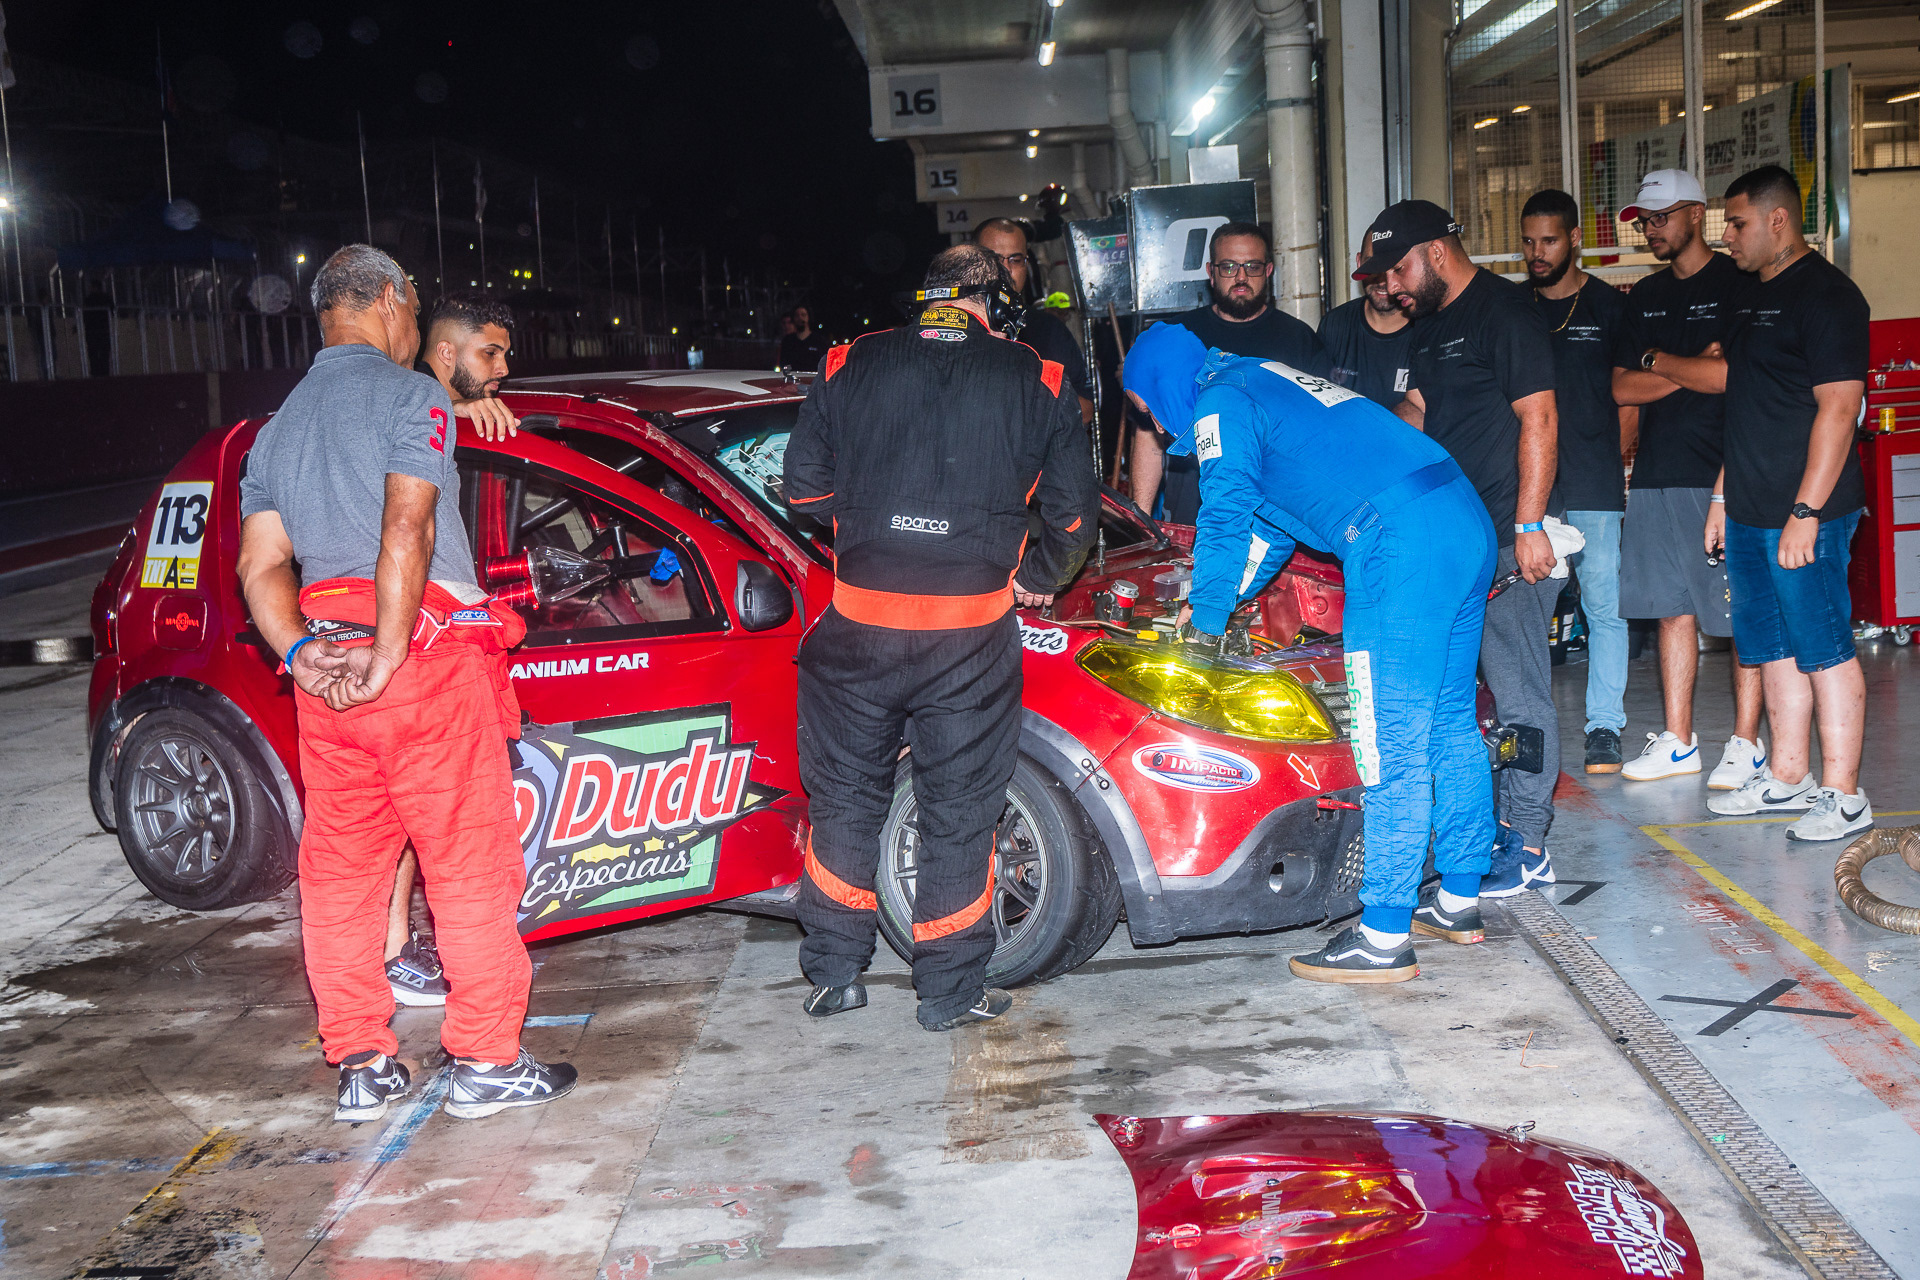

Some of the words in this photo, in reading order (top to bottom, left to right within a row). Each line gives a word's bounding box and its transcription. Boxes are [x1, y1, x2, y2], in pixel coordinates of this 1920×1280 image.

[894, 88, 936, 116] 16
[930, 169, 957, 189] 15
[946, 209, 969, 223] 14
[156, 494, 209, 545] 113
[890, 515, 949, 531] sparco
[143, 559, 168, 584] TN1
[452, 610, 490, 621] sparco
[1020, 629, 1063, 650] arts
[509, 658, 589, 680] ANIUM
[595, 652, 649, 673] CAR
[1360, 655, 1378, 780] AGROFLORESTAL
[1170, 757, 1239, 776] IMPACTO
[546, 737, 752, 849] Dudu
[521, 848, 692, 908] Especiais
[387, 966, 425, 988] FILA
